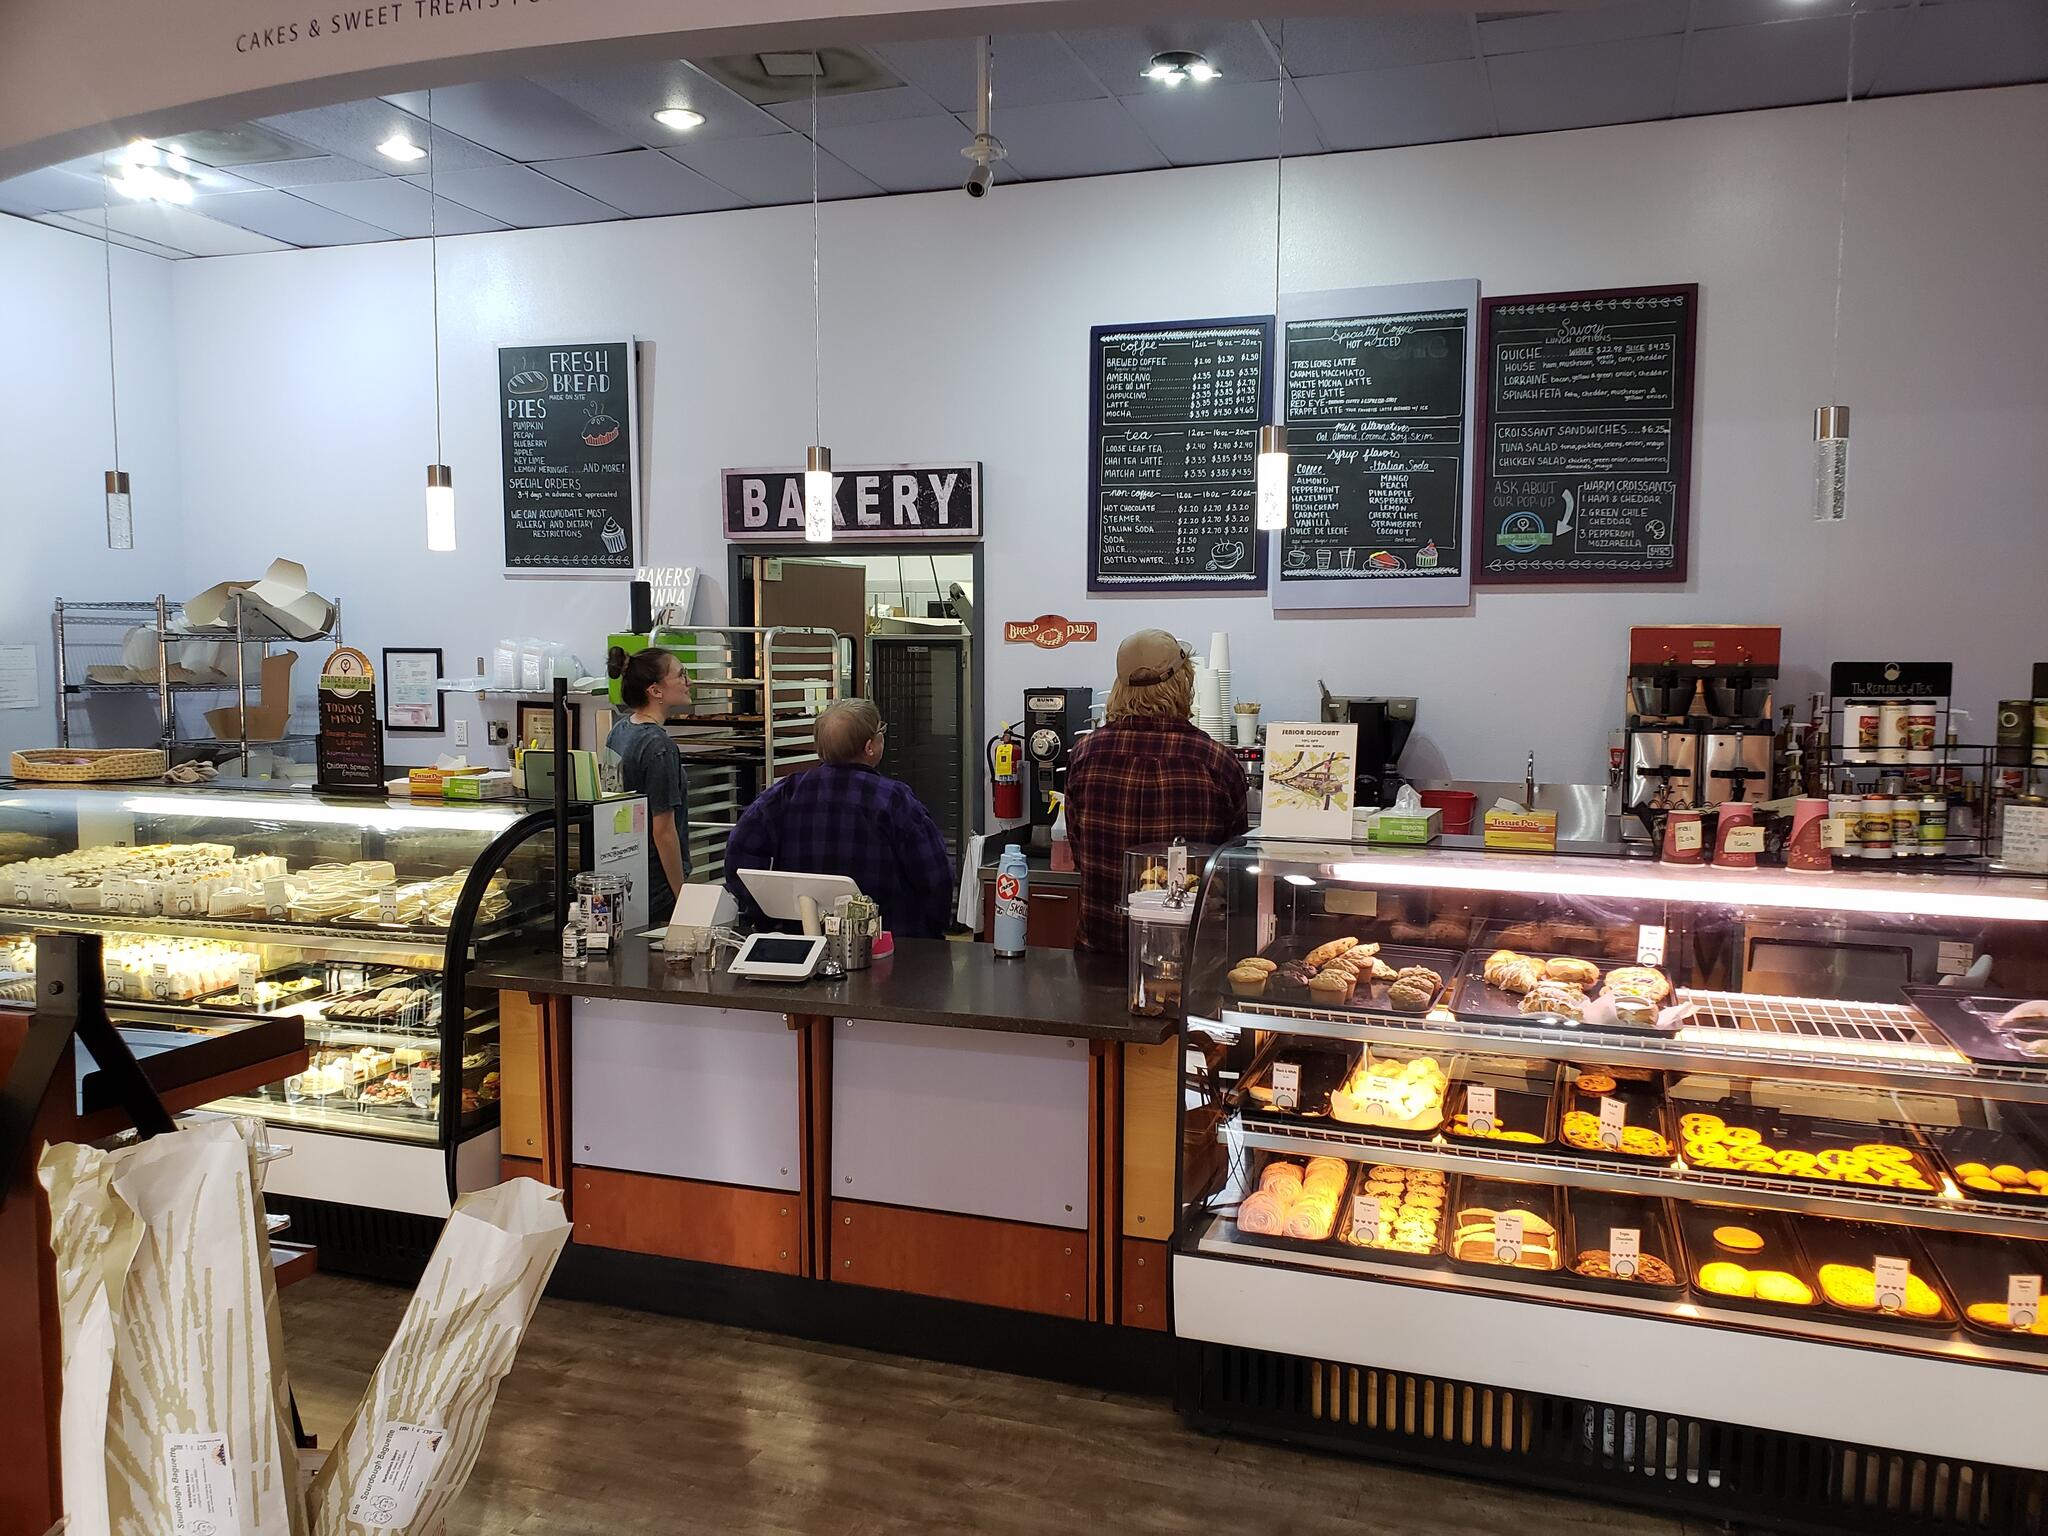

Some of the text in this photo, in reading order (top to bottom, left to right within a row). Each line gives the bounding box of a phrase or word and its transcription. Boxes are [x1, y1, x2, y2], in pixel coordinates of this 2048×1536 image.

[236, 24, 298, 52] CAKES
[309, 19, 320, 37] &
[331, 4, 401, 33] SWEET
[1346, 340, 1362, 348] HOT
[1376, 337, 1401, 347] ICED
[1545, 335, 1611, 344] LUNCH OPTIONS
[1501, 348, 1542, 361] QUICHE
[550, 350, 608, 372] FRESH
[1107, 358, 1138, 367] BREWED
[1140, 357, 1167, 366] COFFEE
[1334, 358, 1356, 368] LATTE
[1505, 362, 1535, 372] HOUSE
[1107, 373, 1150, 382] AMERICANO
[1290, 369, 1365, 378] CARAMEL MACCHIATO
[553, 374, 610, 392] BREAD
[1289, 378, 1372, 389] WHITE MOCHA LATTE
[1504, 374, 1548, 386] LORRAINE
[1106, 392, 1147, 400] CAPPUCCINO
[1503, 388, 1561, 400] SPINACH FETA
[1291, 400, 1305, 408] RED
[1309, 398, 1325, 407] EYE
[508, 399, 546, 418] PIES
[1290, 407, 1317, 416] FRAPPE
[1321, 406, 1343, 415] LATTE
[513, 422, 544, 430] PUMPKIN
[1499, 427, 1555, 438] CROISSANT
[1558, 424, 1627, 436] SANDWICHES
[1125, 429, 1152, 441] tea
[514, 440, 547, 448] BLUEBERRY
[1149, 445, 1162, 453] TEA
[1500, 442, 1558, 452] TUNA SALAD
[1499, 456, 1566, 466] CHICKEN SALAD
[539, 466, 568, 474] MERINGUE
[584, 463, 599, 473] AND
[602, 463, 625, 473] MORE!
[1105, 469, 1161, 478] MATCHA LATTE
[1381, 474, 1409, 482] MANGO
[509, 478, 580, 490] SPECIAL ORDERS
[1495, 481, 1558, 494] ASK ABOUT
[1583, 480, 1673, 493] WARM CROISSANTS
[1292, 486, 1340, 494] PEPPERMINT
[742, 472, 958, 528] BAKERY
[1494, 496, 1513, 508] OUR
[1588, 495, 1609, 503] HAM
[1620, 494, 1662, 505] CHEDDAR
[1104, 504, 1118, 512] HOT
[1120, 504, 1156, 512] CHOCOLATE
[1314, 503, 1339, 511] CREAM
[511, 510, 522, 519] WE
[524, 510, 537, 519] CAN
[587, 508, 607, 518] MOST
[1400, 512, 1419, 520] LIME
[1589, 508, 1619, 517] GREEN
[1622, 508, 1649, 517] CHILE
[1103, 515, 1141, 523] STEAMER
[1371, 520, 1423, 528] STRAWBERRY
[1589, 517, 1632, 525] CHEDDAR
[516, 520, 593, 529] ALLERGY AND DIETARY
[533, 530, 582, 538] RESTRICTIONS
[1104, 526, 1154, 534] ITALIAN SODA
[1290, 527, 1312, 535] DULCE
[1327, 527, 1350, 535] LECHE
[1376, 529, 1410, 537] COCONUT
[1589, 530, 1635, 538] PEPPERONI
[1103, 535, 1125, 543] SODA
[1588, 539, 1642, 547] MOZZARELLA
[1103, 545, 1126, 553] JUICE
[1104, 556, 1164, 565] BOTTLED WATER
[638, 567, 691, 587] BAKERS
[651, 589, 685, 607] ONNA
[1008, 624, 1093, 640] BREAD DAILY
[325, 703, 364, 714] TODAYS
[331, 715, 360, 724] MENU
[1492, 818, 1520, 827] Tissue
[361, 1430, 395, 1500] Sourdough Baguette
[170, 1447, 184, 1529] Sourdough Baguette
